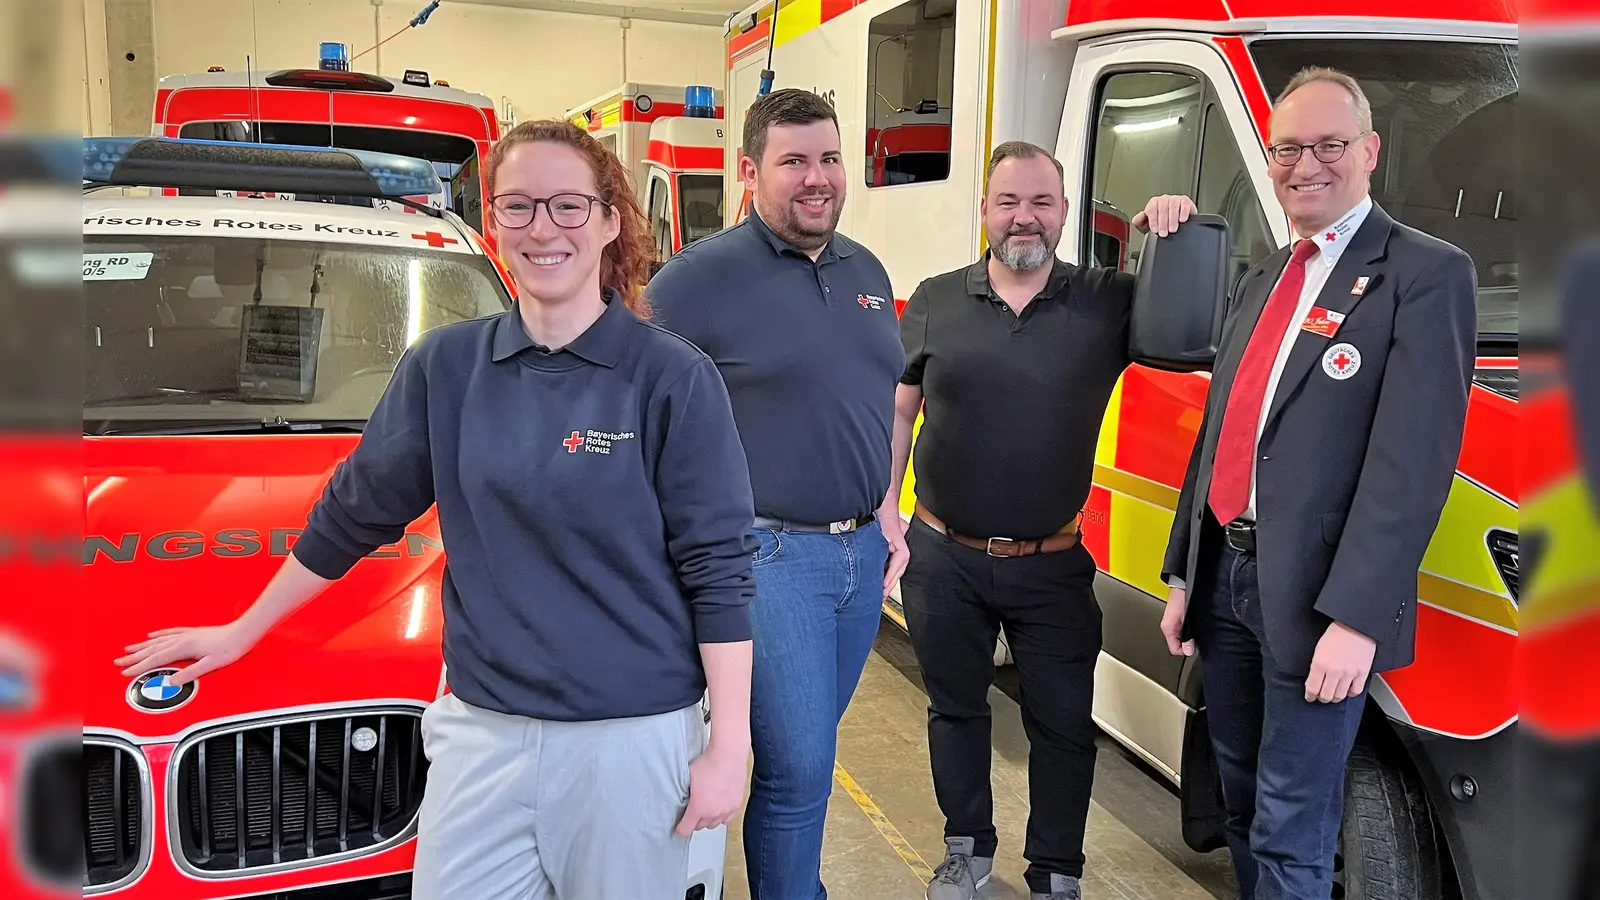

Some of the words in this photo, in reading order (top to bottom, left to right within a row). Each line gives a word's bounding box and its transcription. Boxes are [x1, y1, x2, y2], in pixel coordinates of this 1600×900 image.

[213, 218, 303, 231] Rotes
[314, 223, 400, 238] Kreuz
[107, 257, 129, 266] RD
[586, 429, 635, 441] Bayerisches
[586, 437, 611, 447] Rotes
[585, 444, 611, 455] Kreuz
